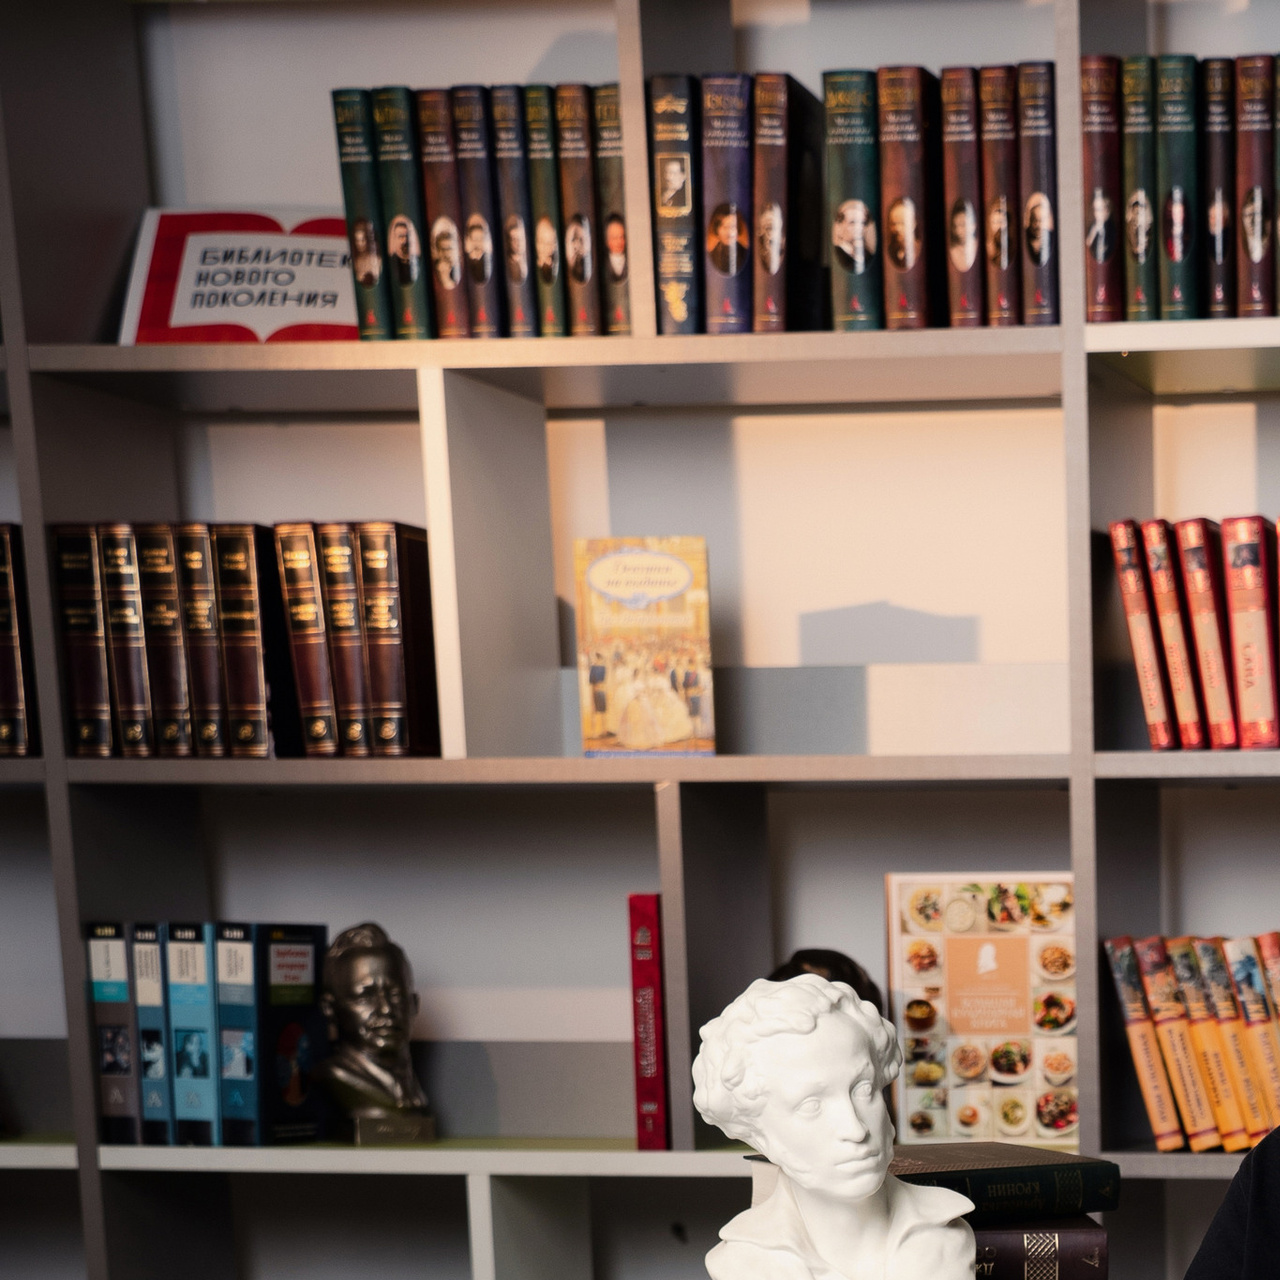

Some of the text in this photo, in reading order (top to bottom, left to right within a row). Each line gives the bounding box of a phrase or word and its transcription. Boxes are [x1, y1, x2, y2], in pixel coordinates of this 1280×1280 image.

[199, 247, 353, 267] БИБЛИОТЕК
[196, 268, 296, 287] НОВОГО
[190, 289, 338, 308] ПОКОЛЕНИЯ
[987, 1181, 1041, 1198] КРОНИН
